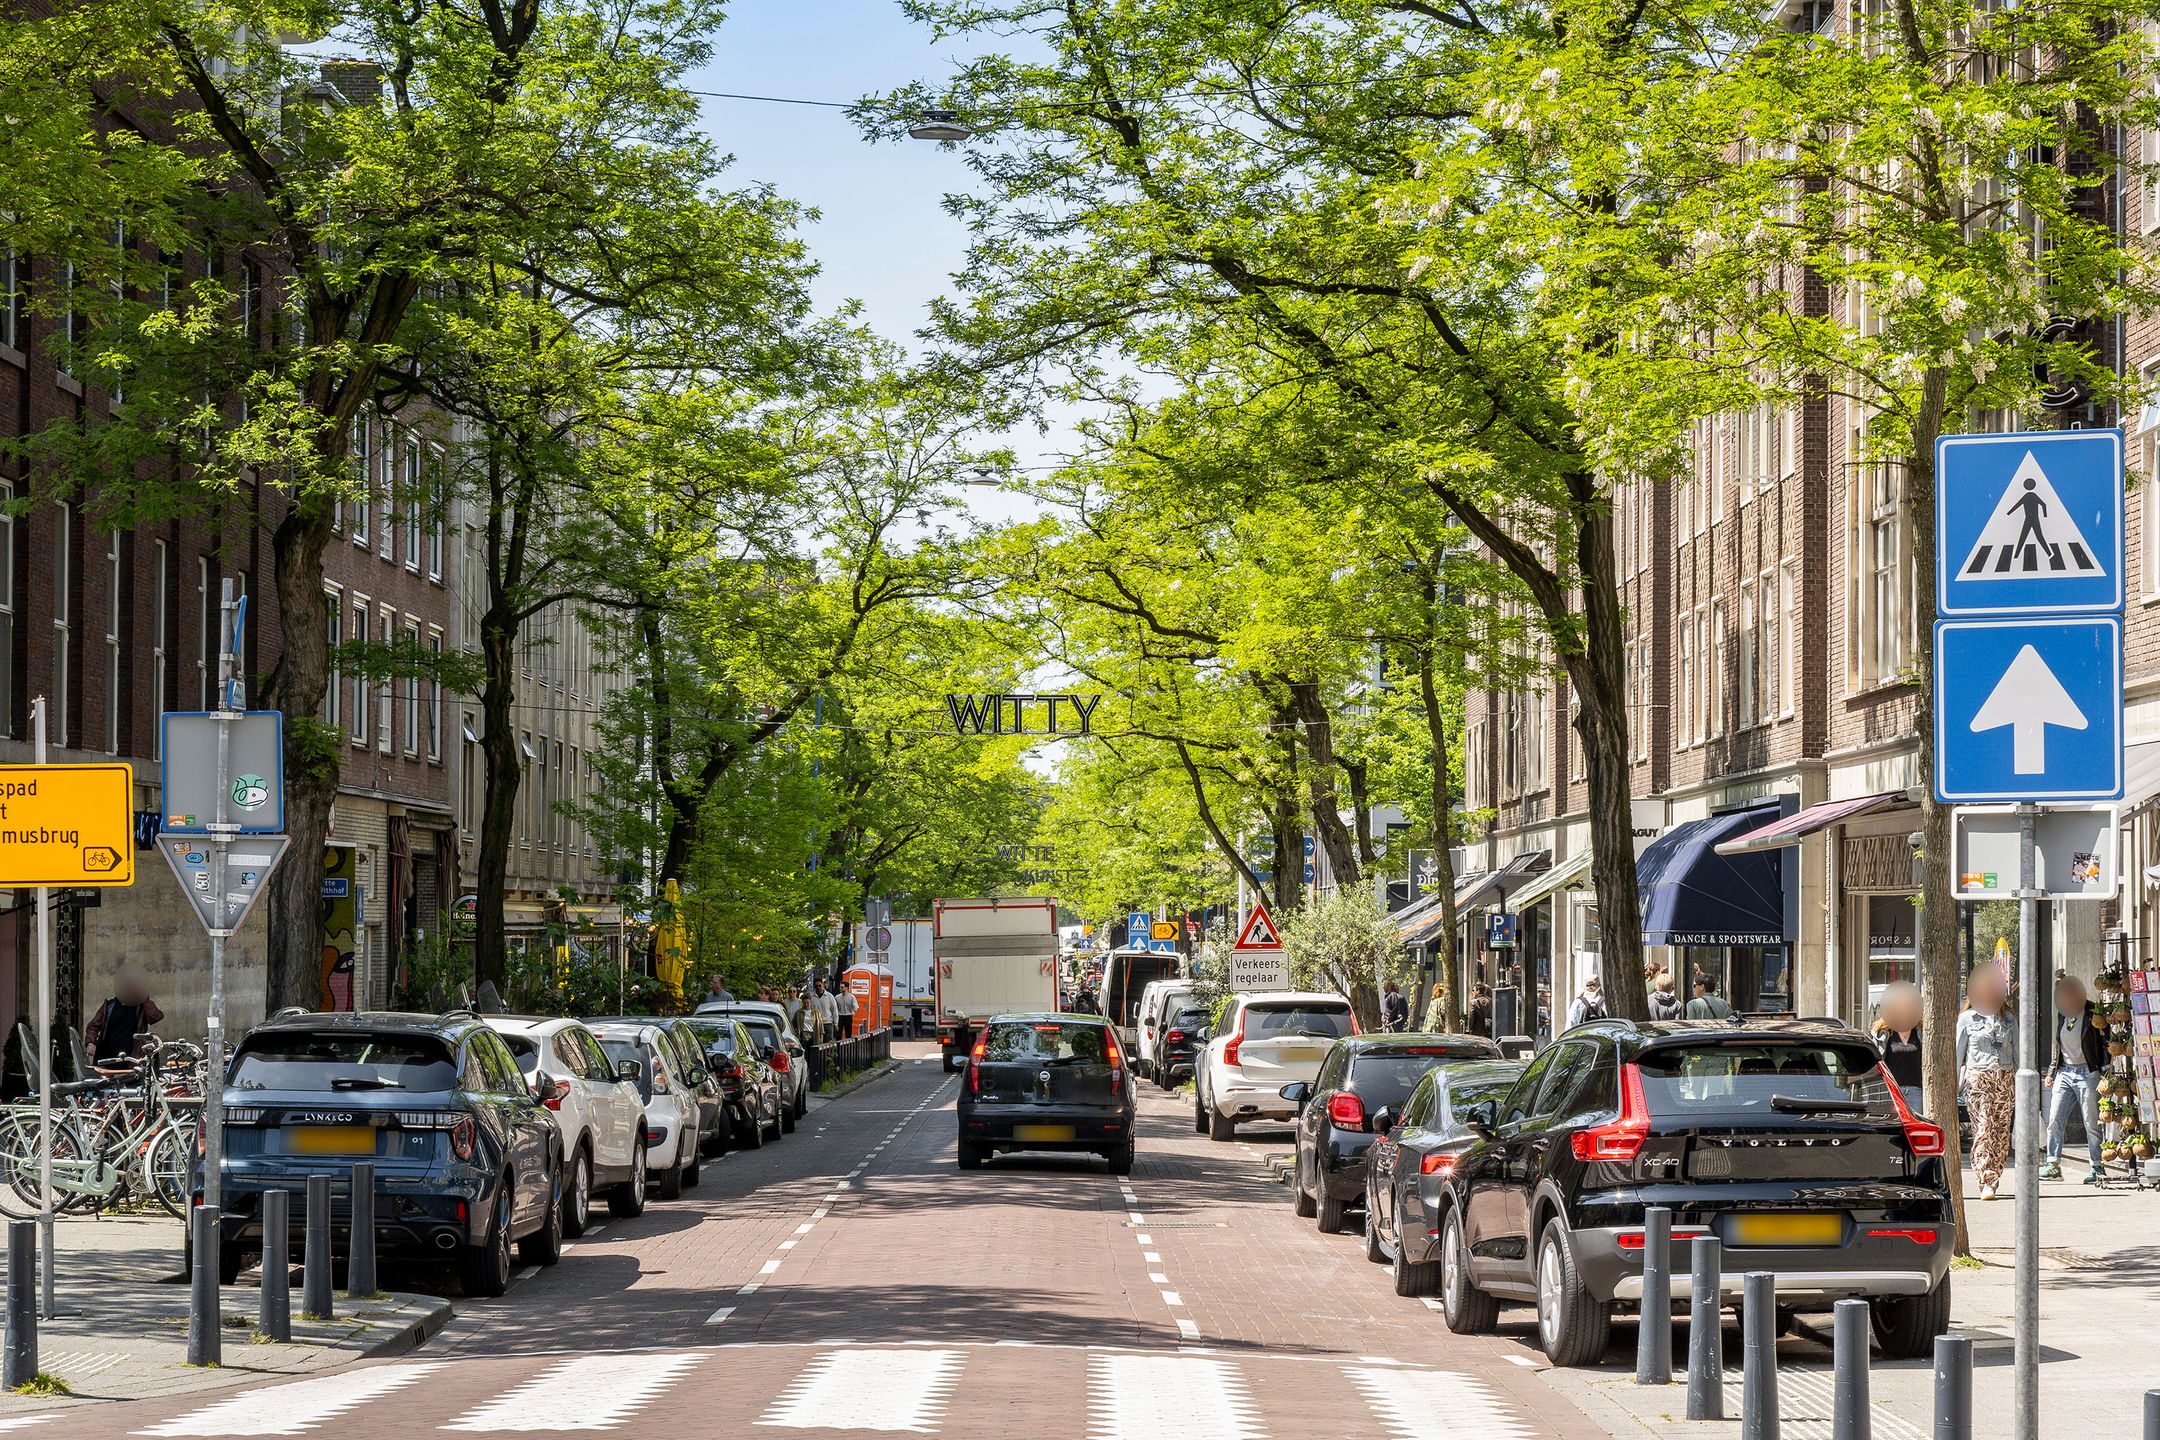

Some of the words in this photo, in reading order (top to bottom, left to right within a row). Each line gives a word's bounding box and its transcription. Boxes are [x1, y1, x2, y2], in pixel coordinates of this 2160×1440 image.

[946, 694, 1102, 734] WITTY
[995, 845, 1055, 861] WITTE
[1493, 915, 1505, 931] P
[1674, 934, 1707, 944] DANCE
[1709, 934, 1716, 944] &
[1718, 934, 1782, 944] SPORTSWEAR
[1235, 958, 1281, 970] Verkeers
[1235, 972, 1278, 986] regelaar
[411, 1137, 423, 1145] 01
[1720, 1138, 1841, 1147] VOLVO
[1889, 1156, 1904, 1164] T2
